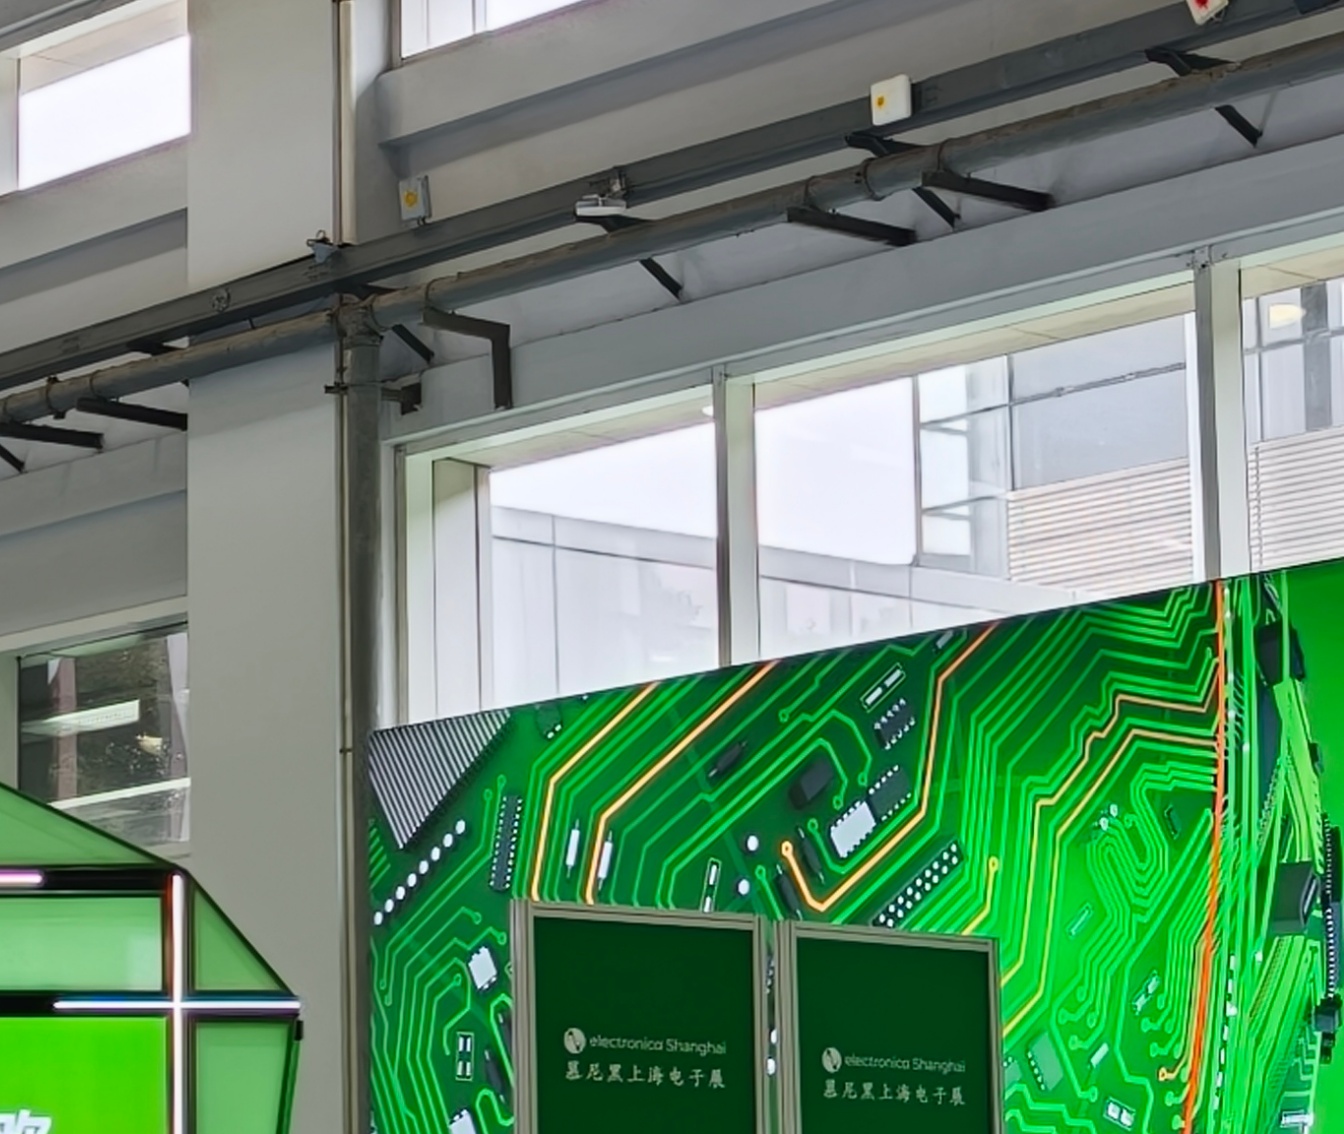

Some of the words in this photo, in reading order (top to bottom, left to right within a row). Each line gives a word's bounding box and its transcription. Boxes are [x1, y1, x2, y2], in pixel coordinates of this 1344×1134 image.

[589, 1034, 663, 1051] electronica
[665, 1038, 727, 1056] Shanghai
[564, 1060, 726, 1089] 慕尼黑上海电子展
[844, 1053, 910, 1069] electronica
[912, 1057, 966, 1075] Shanghai
